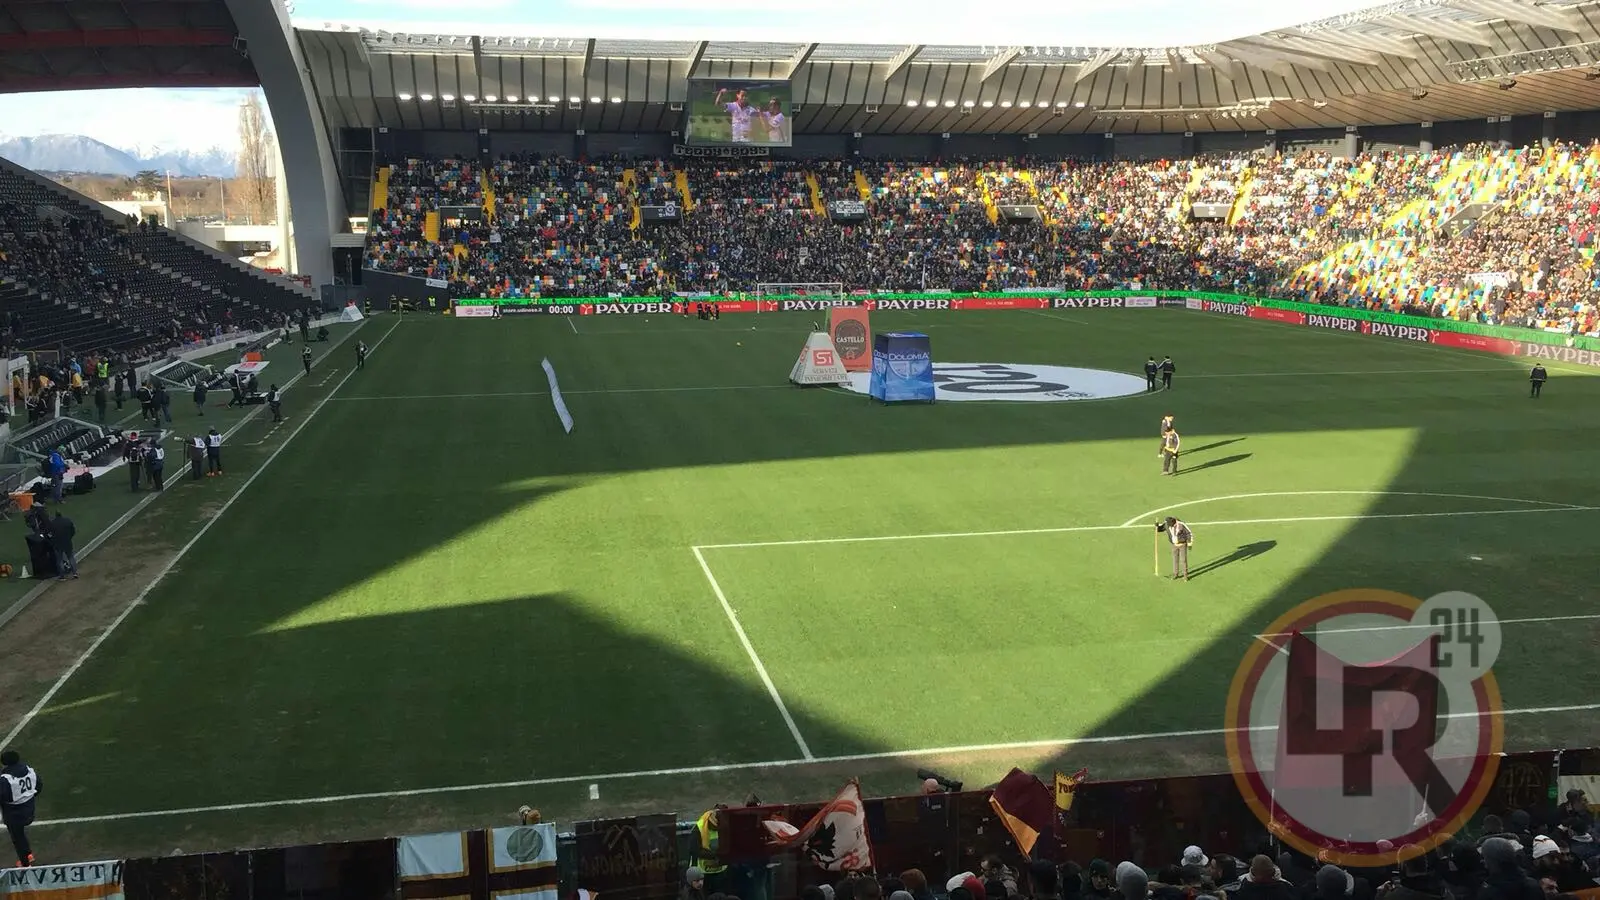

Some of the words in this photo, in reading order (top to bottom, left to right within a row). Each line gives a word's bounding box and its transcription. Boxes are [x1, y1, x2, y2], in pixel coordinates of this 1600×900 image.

[596, 303, 671, 313] PAYPER
[878, 300, 949, 310] PAYPER
[1055, 298, 1122, 308] PAYPER
[1210, 303, 1246, 315] PAYPER
[549, 306, 573, 314] 00:00
[1309, 314, 1357, 331] PAYPER
[1372, 322, 1428, 341] PAYPER
[1527, 343, 1600, 367] PAYPER
[19, 776, 32, 794] 20
